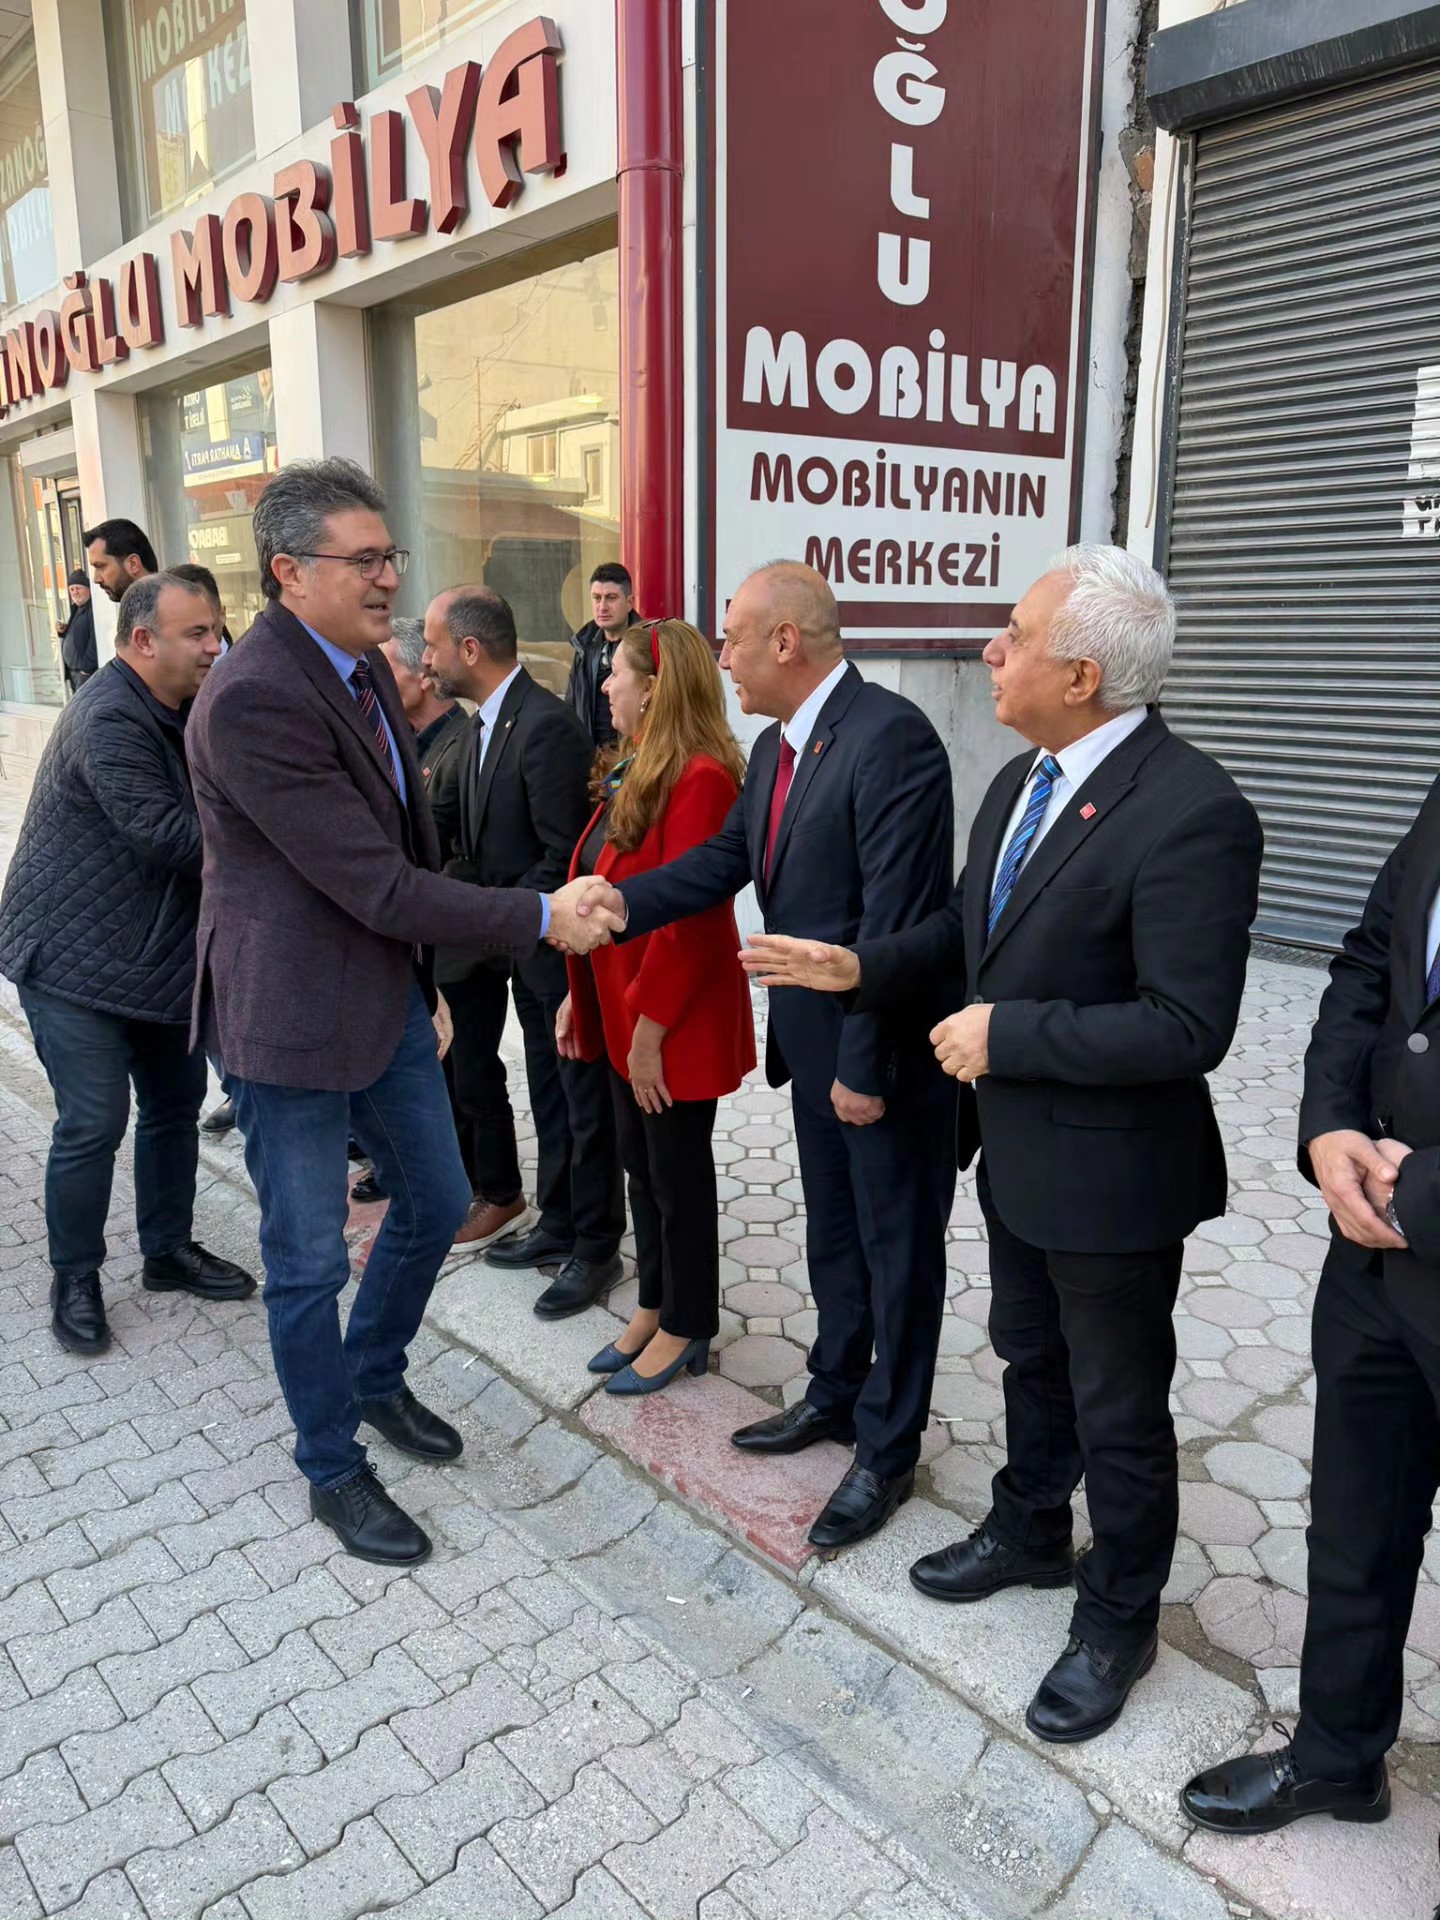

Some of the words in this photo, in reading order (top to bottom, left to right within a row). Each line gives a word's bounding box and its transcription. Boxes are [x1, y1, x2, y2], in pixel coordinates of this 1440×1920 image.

[171, 16, 567, 330] MOBİLYA
[743, 326, 1057, 434] MOBİLYA
[749, 448, 1047, 519] MOBİLYANIN
[804, 531, 1002, 588] MERKEZİ
